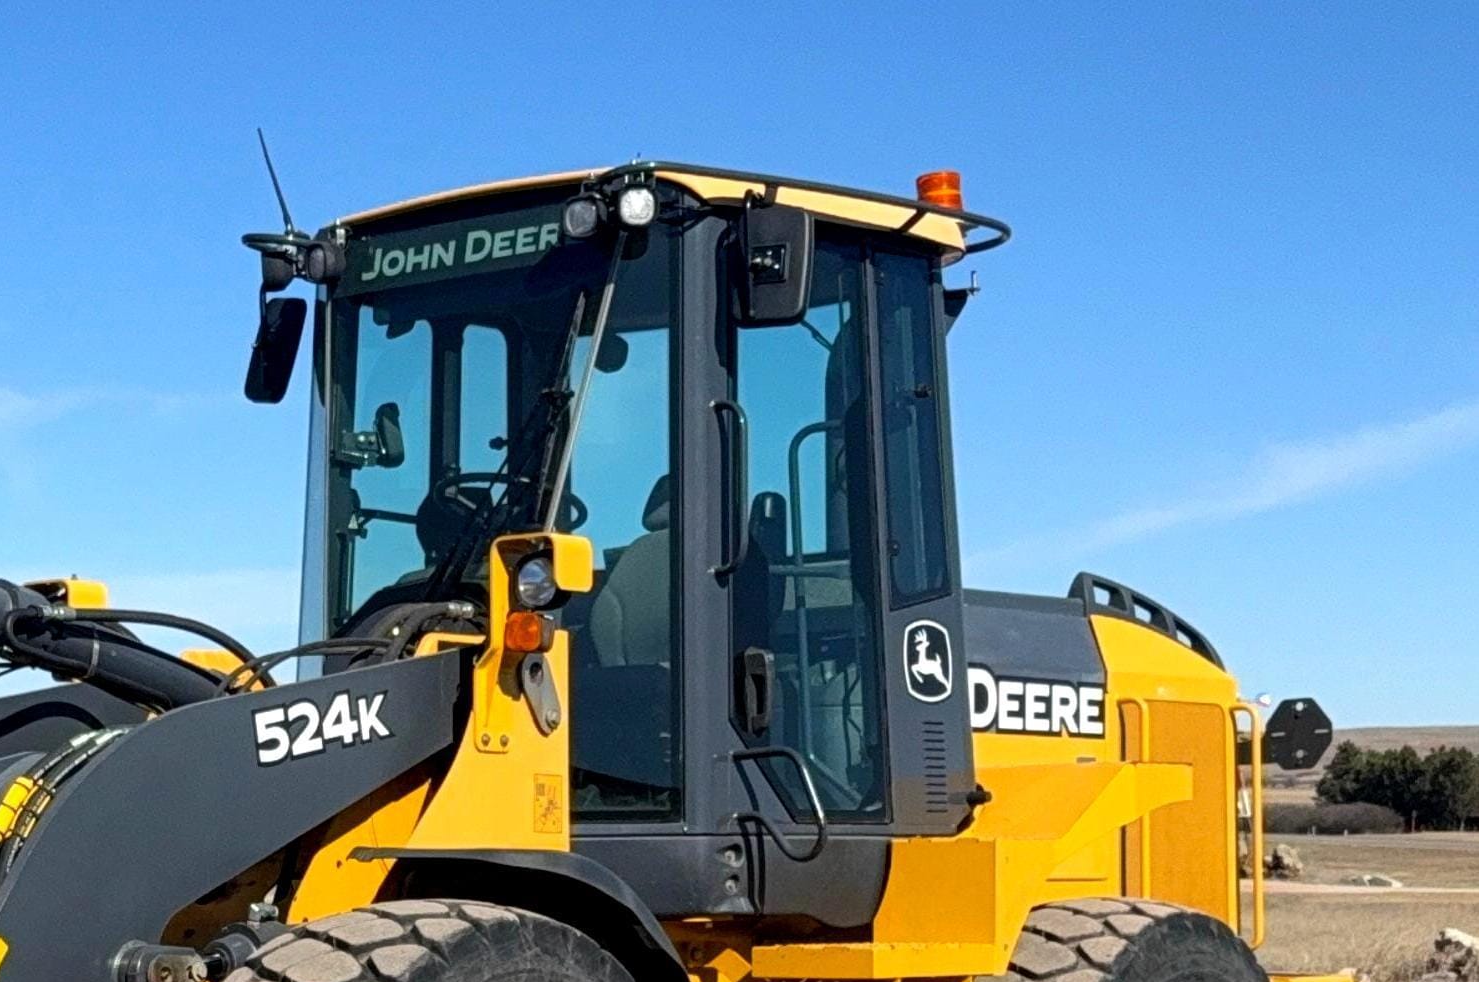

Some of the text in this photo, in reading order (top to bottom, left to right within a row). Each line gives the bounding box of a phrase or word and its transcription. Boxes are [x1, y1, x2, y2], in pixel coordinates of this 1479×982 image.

[361, 222, 560, 281] JOHN DEER
[254, 693, 391, 764] 524K
[967, 667, 1103, 735] DEERE
